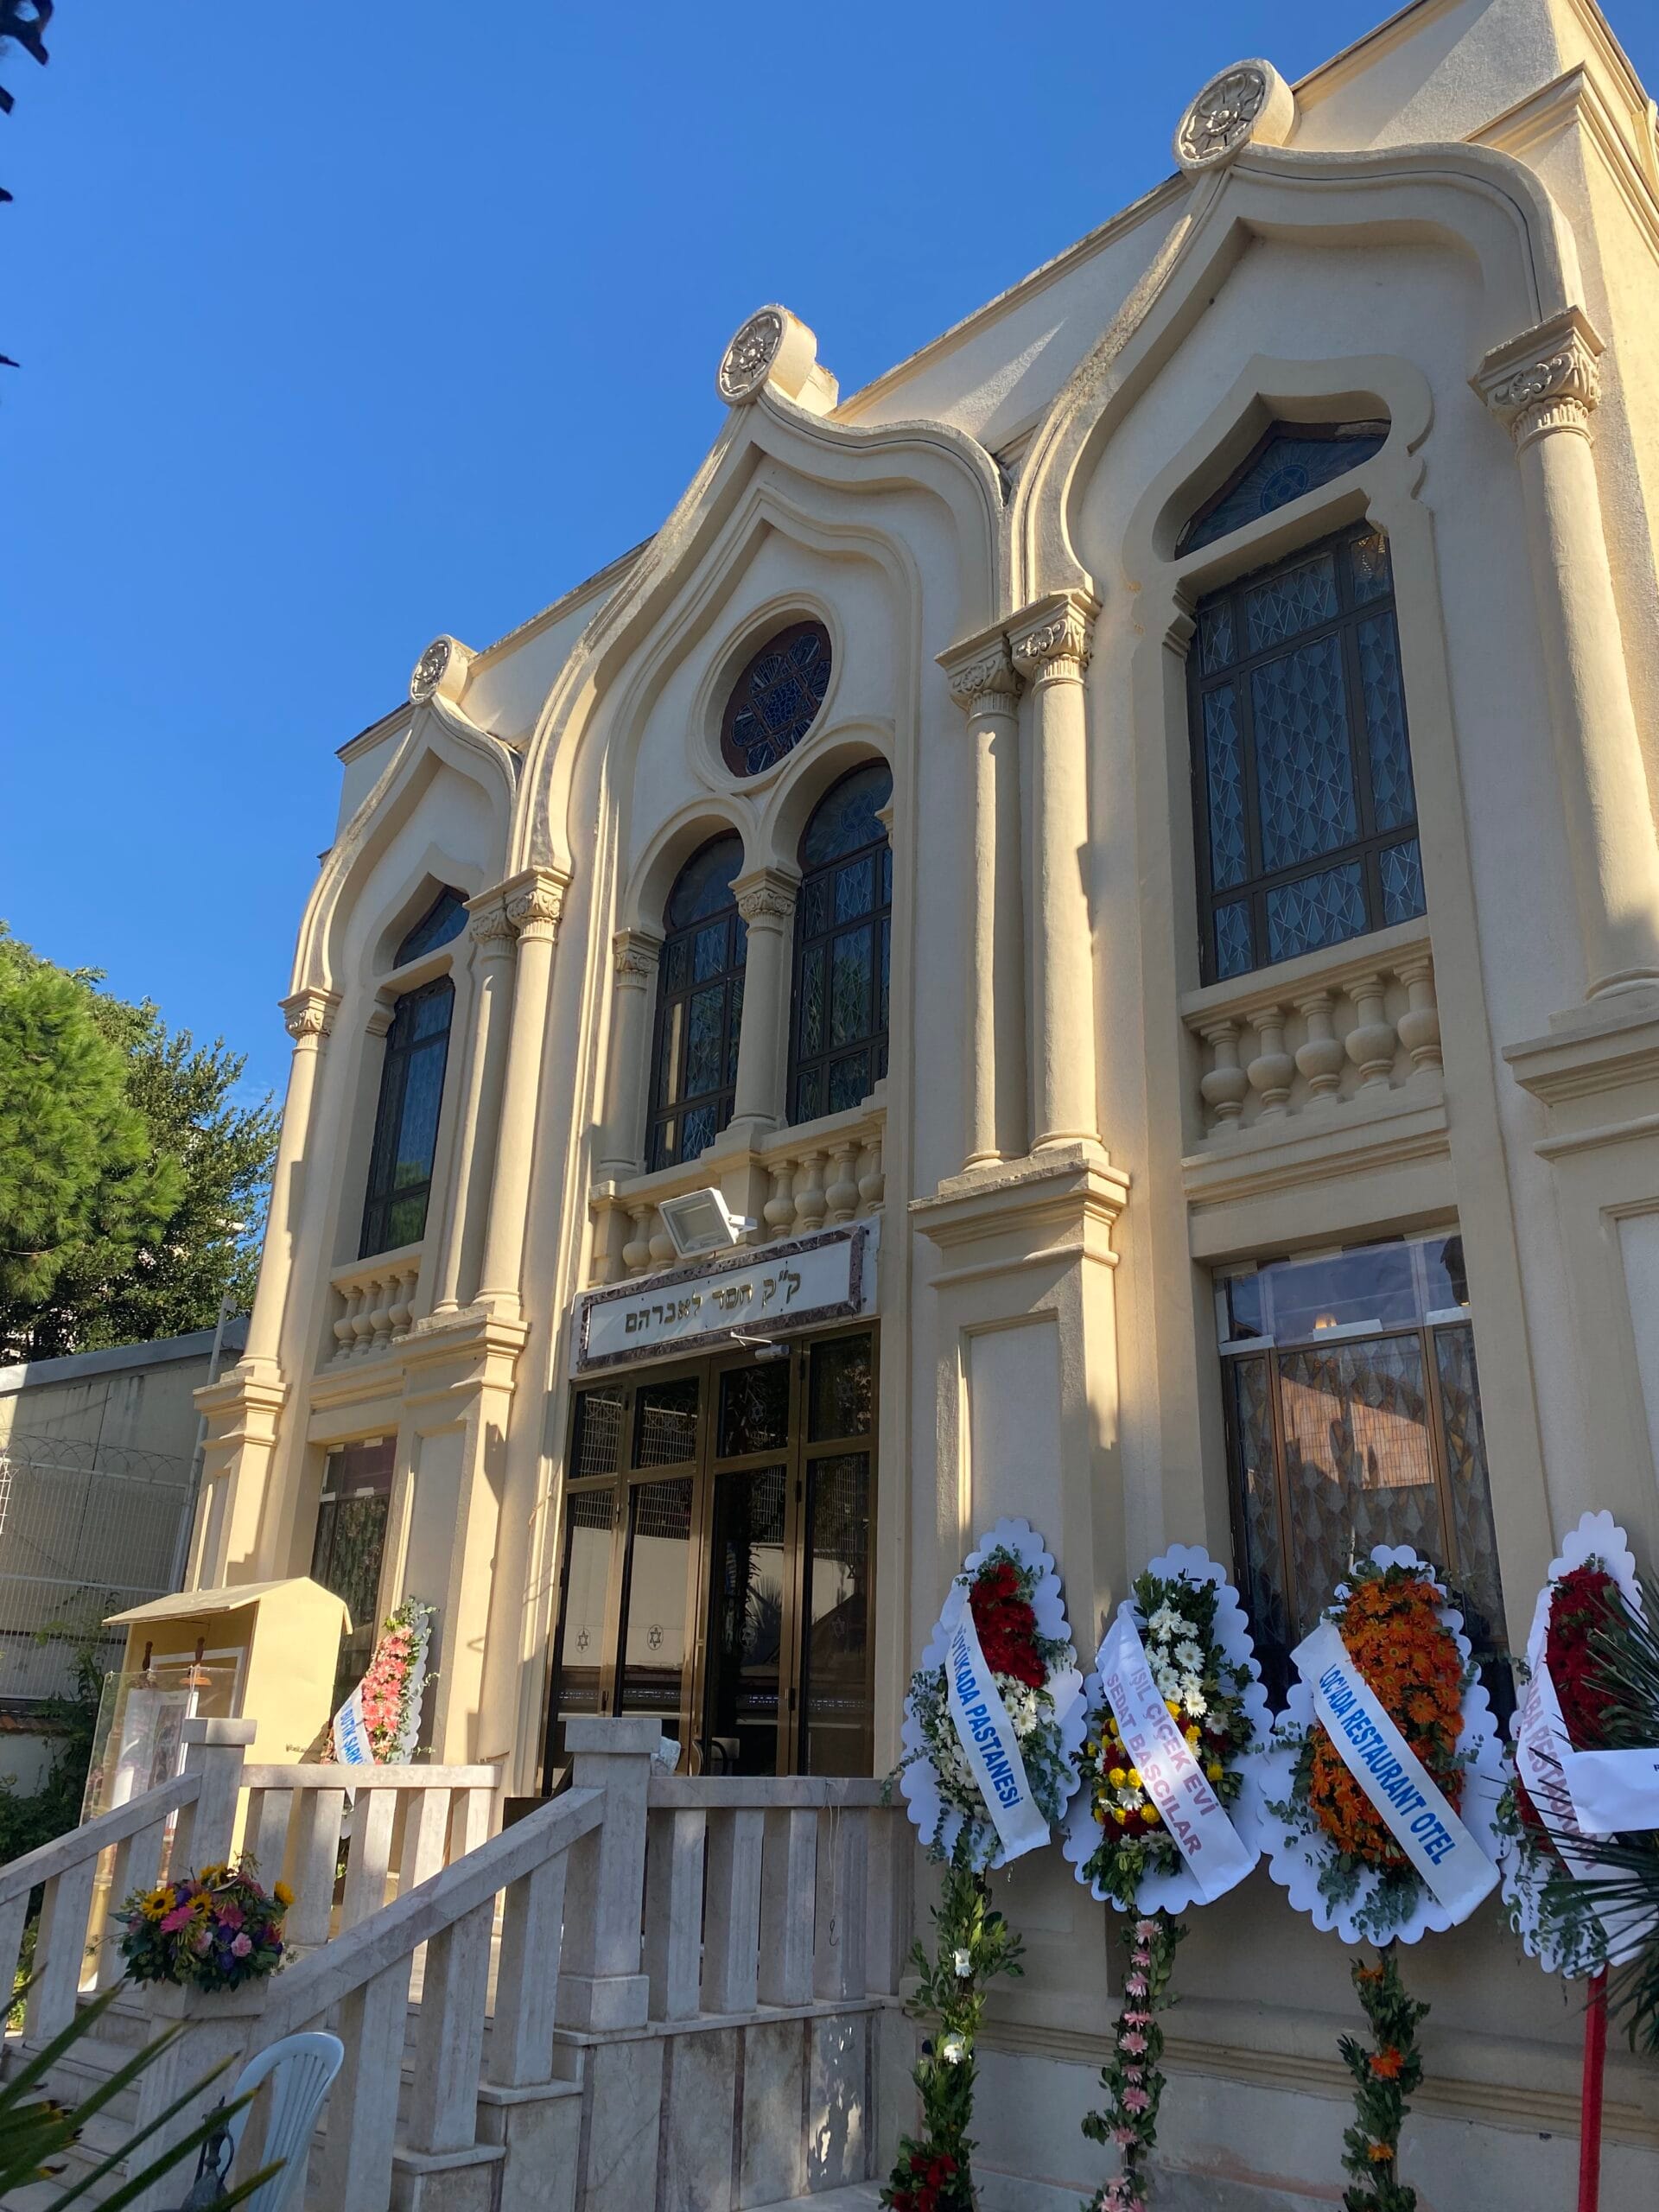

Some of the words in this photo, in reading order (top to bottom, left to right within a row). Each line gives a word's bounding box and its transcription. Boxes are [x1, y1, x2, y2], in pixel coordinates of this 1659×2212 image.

[625, 1288, 703, 1333] לאברהם
[712, 1282, 753, 1310] חסד
[964, 1703, 1024, 1808] PASTANESİ
[1107, 1673, 1137, 1728] SEDAT
[1128, 1733, 1202, 1856] BAŞCILAR
[1142, 1703, 1192, 1772] ÇİÇEK
[1183, 1773, 1220, 1816] EVİ
[1341, 1707, 1427, 1816] RESTAURANT
[1410, 1812, 1456, 1866] OTEL
